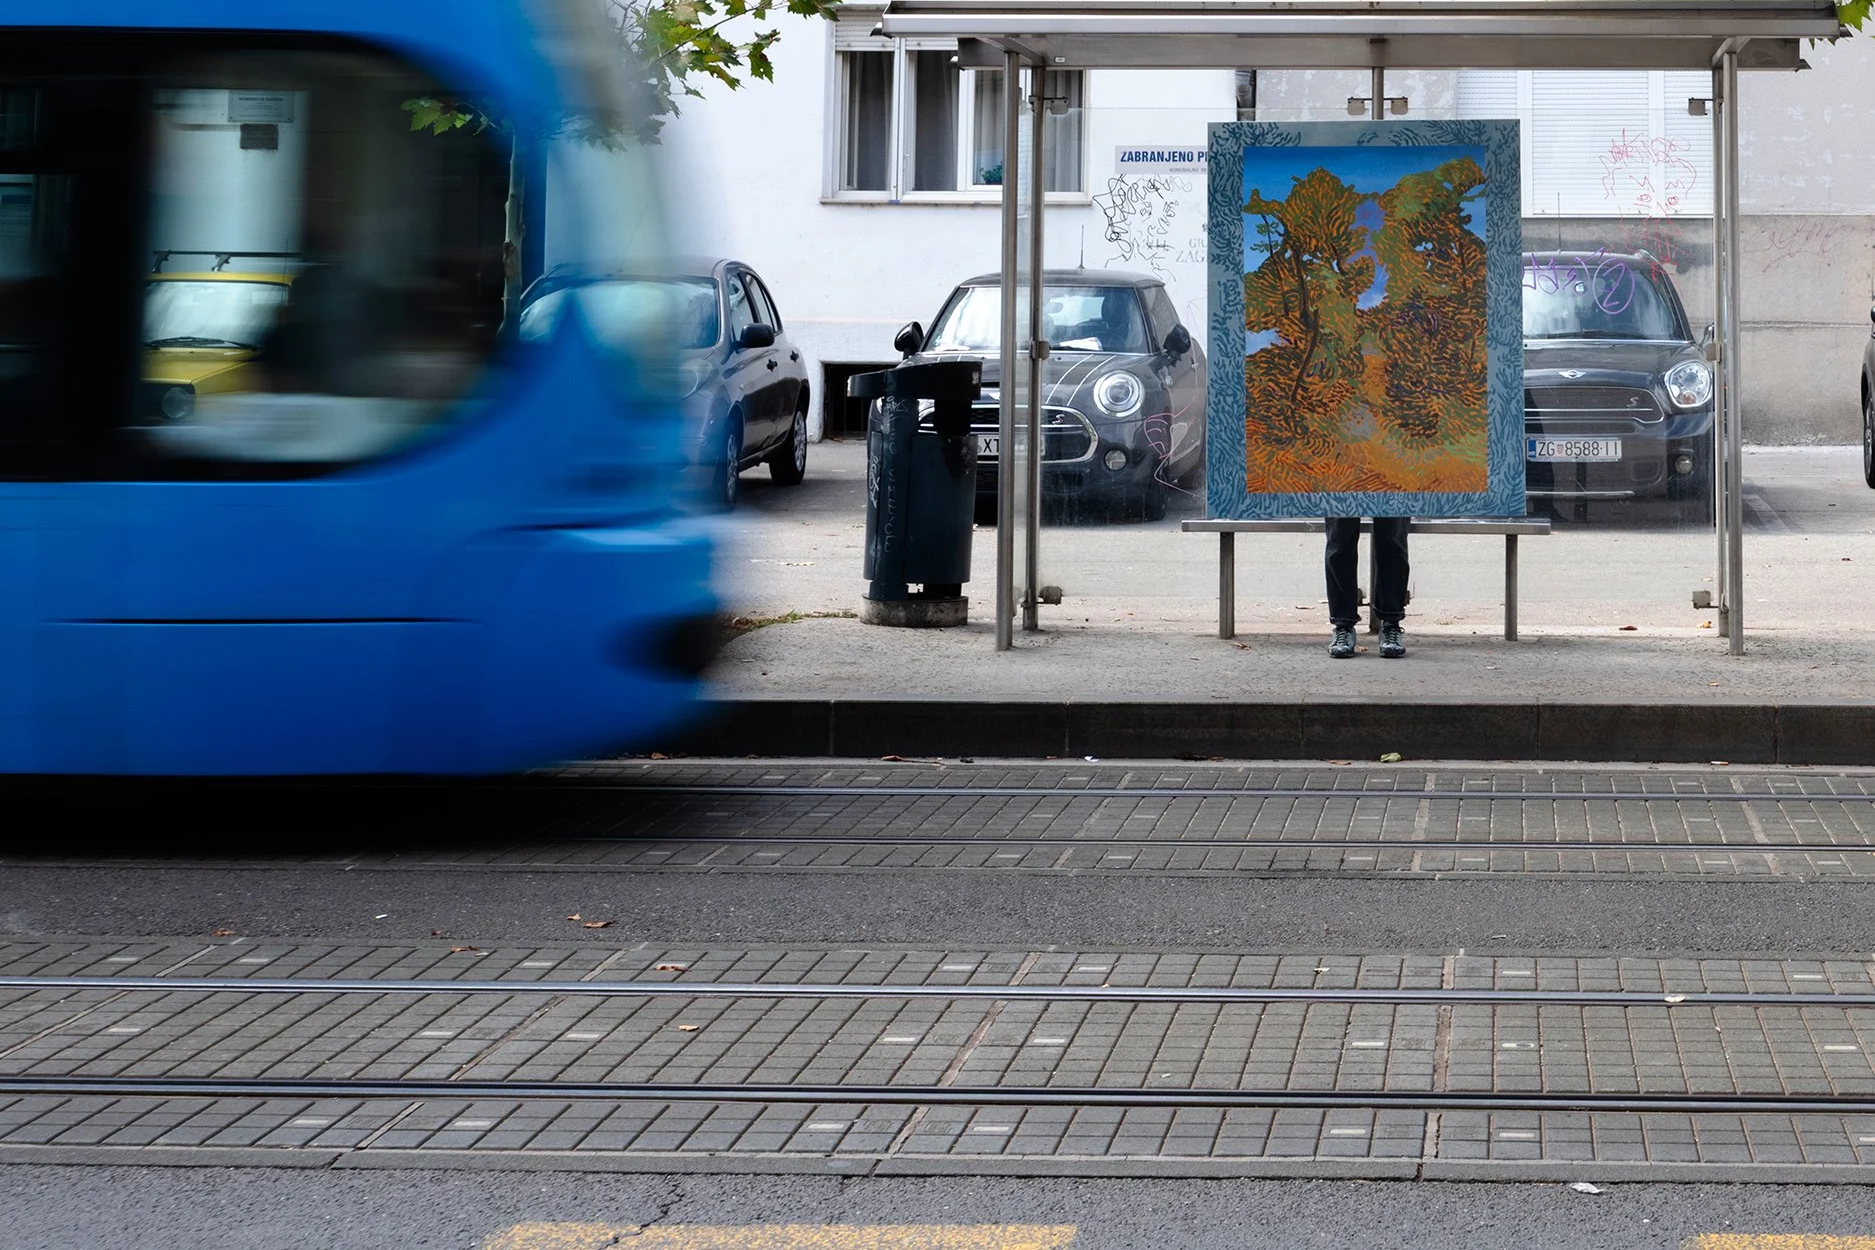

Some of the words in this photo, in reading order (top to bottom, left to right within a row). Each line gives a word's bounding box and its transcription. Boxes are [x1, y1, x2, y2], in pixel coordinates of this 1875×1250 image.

[1120, 150, 1194, 163] ZABRANJENO
[1197, 150, 1208, 163] P
[1538, 441, 1555, 456] ZG
